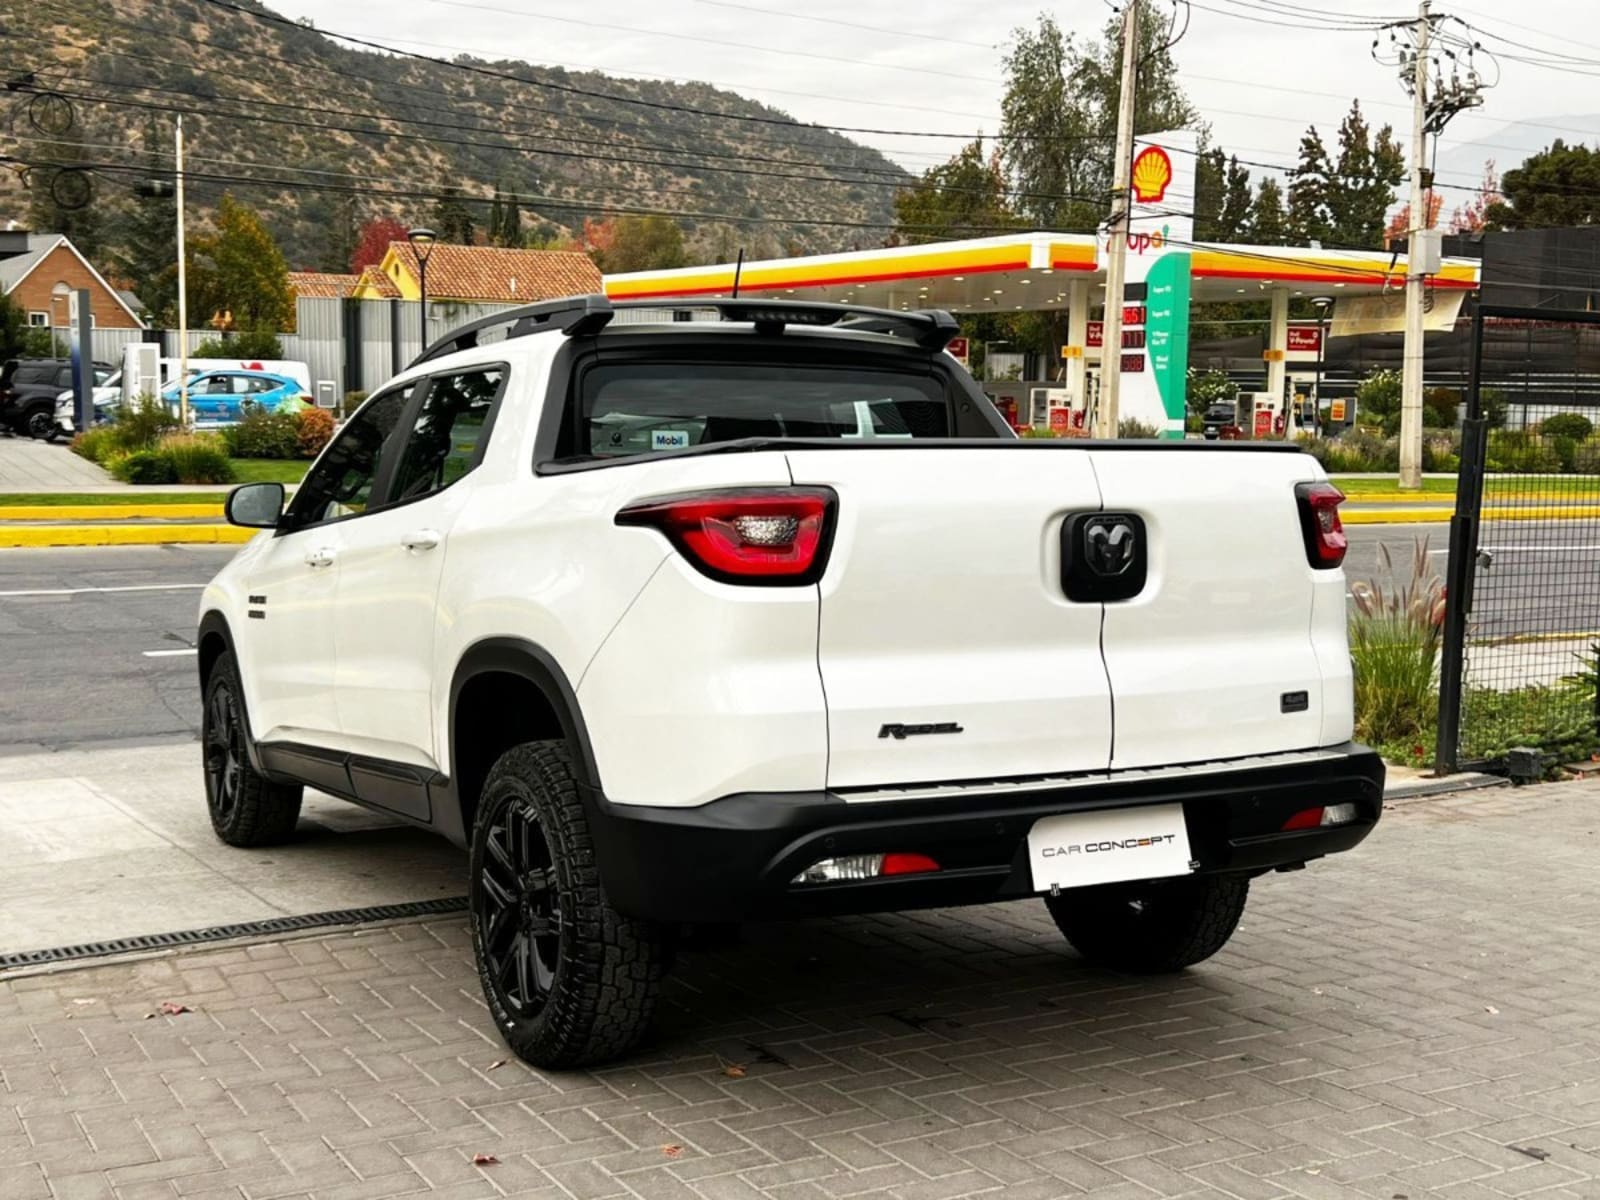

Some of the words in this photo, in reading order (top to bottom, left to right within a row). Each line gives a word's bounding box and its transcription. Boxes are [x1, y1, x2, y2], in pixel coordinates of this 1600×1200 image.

[656, 435, 683, 446] Mobil
[1042, 845, 1081, 858] CAR
[1086, 835, 1175, 853] CONCEPT
